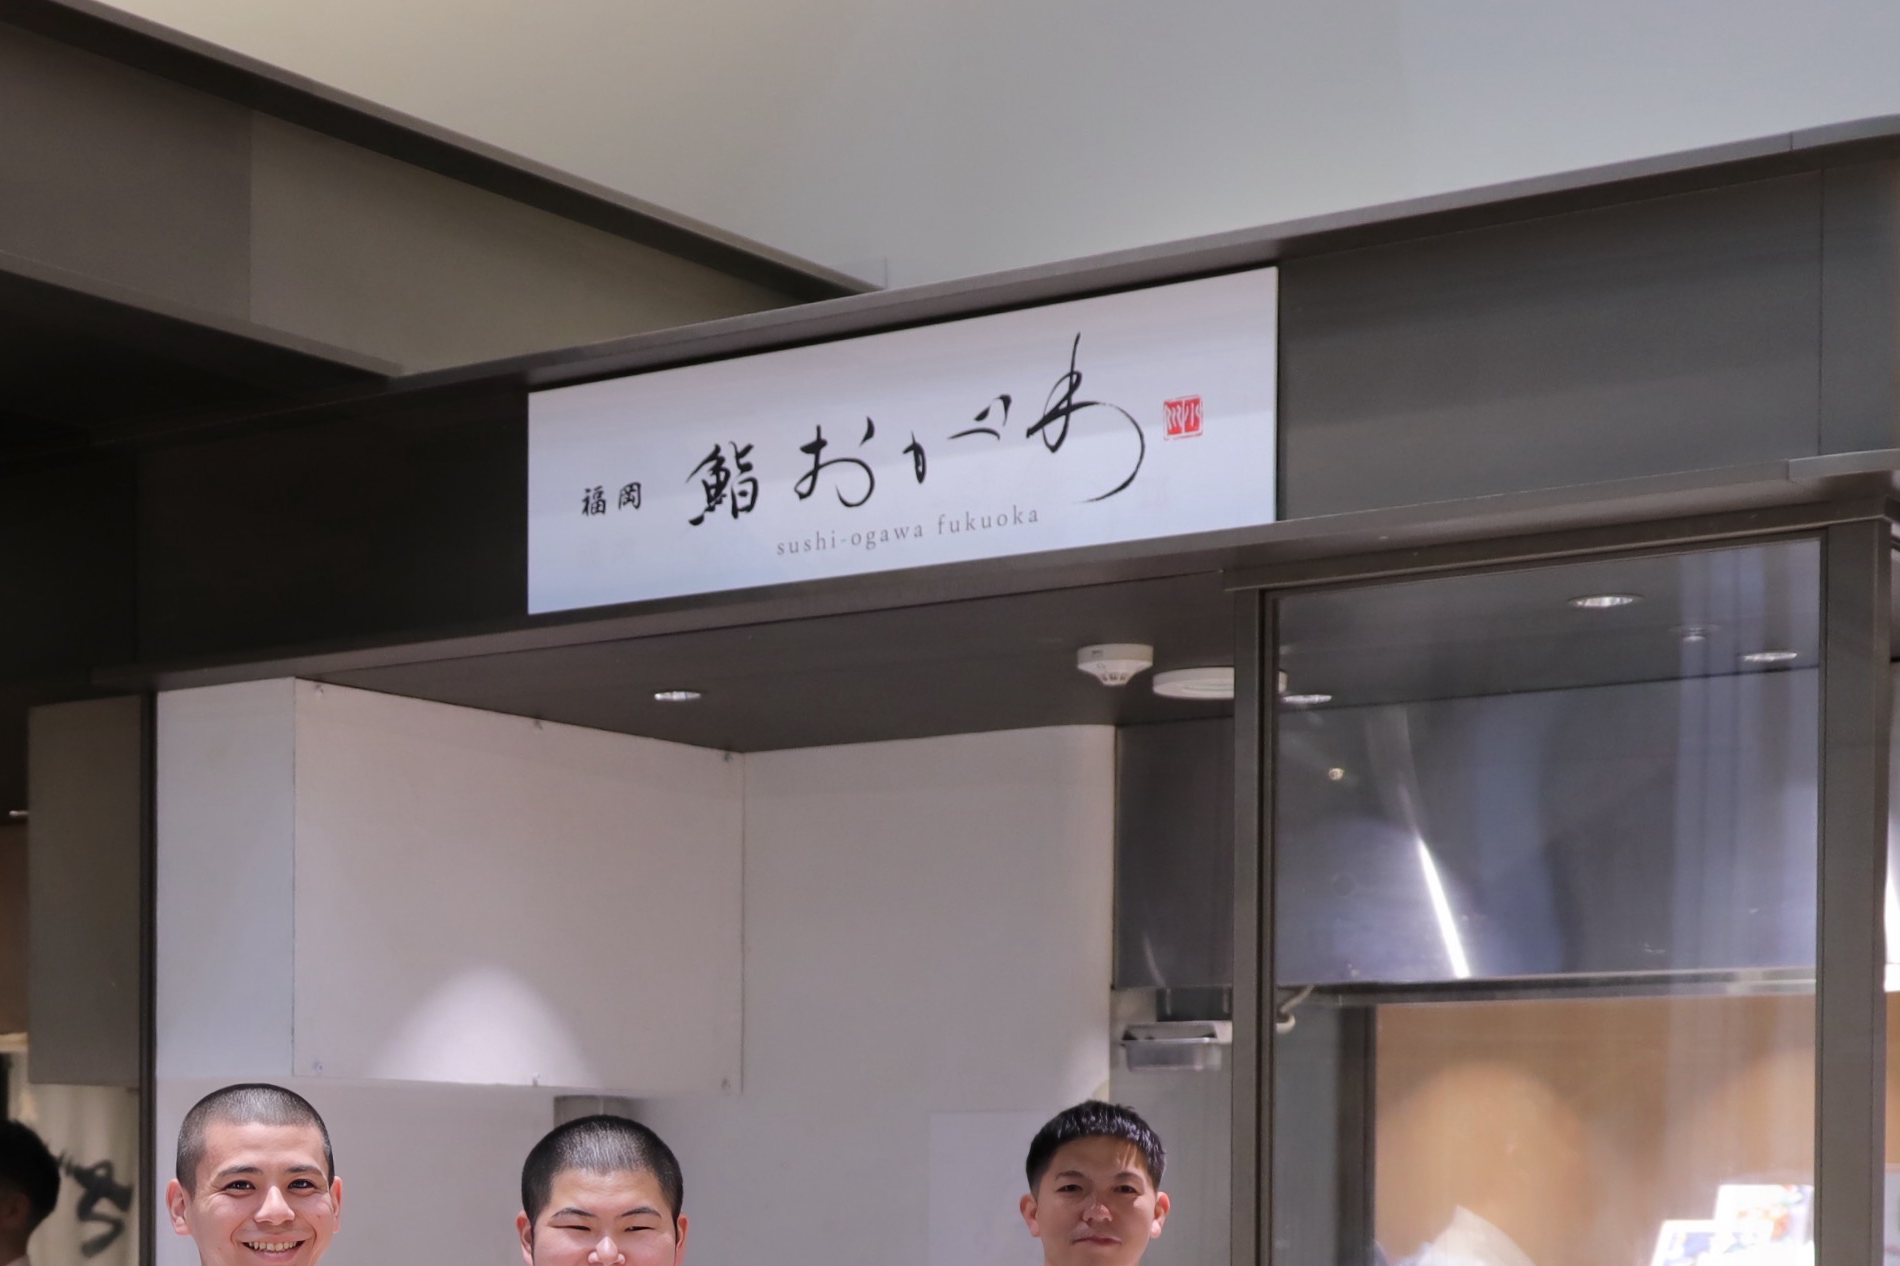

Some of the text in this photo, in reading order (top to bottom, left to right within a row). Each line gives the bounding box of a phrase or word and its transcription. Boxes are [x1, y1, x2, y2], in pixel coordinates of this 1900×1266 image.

[581, 481, 643, 518] 福岡
[776, 506, 1039, 556] sushi-ogawa fukuoka
